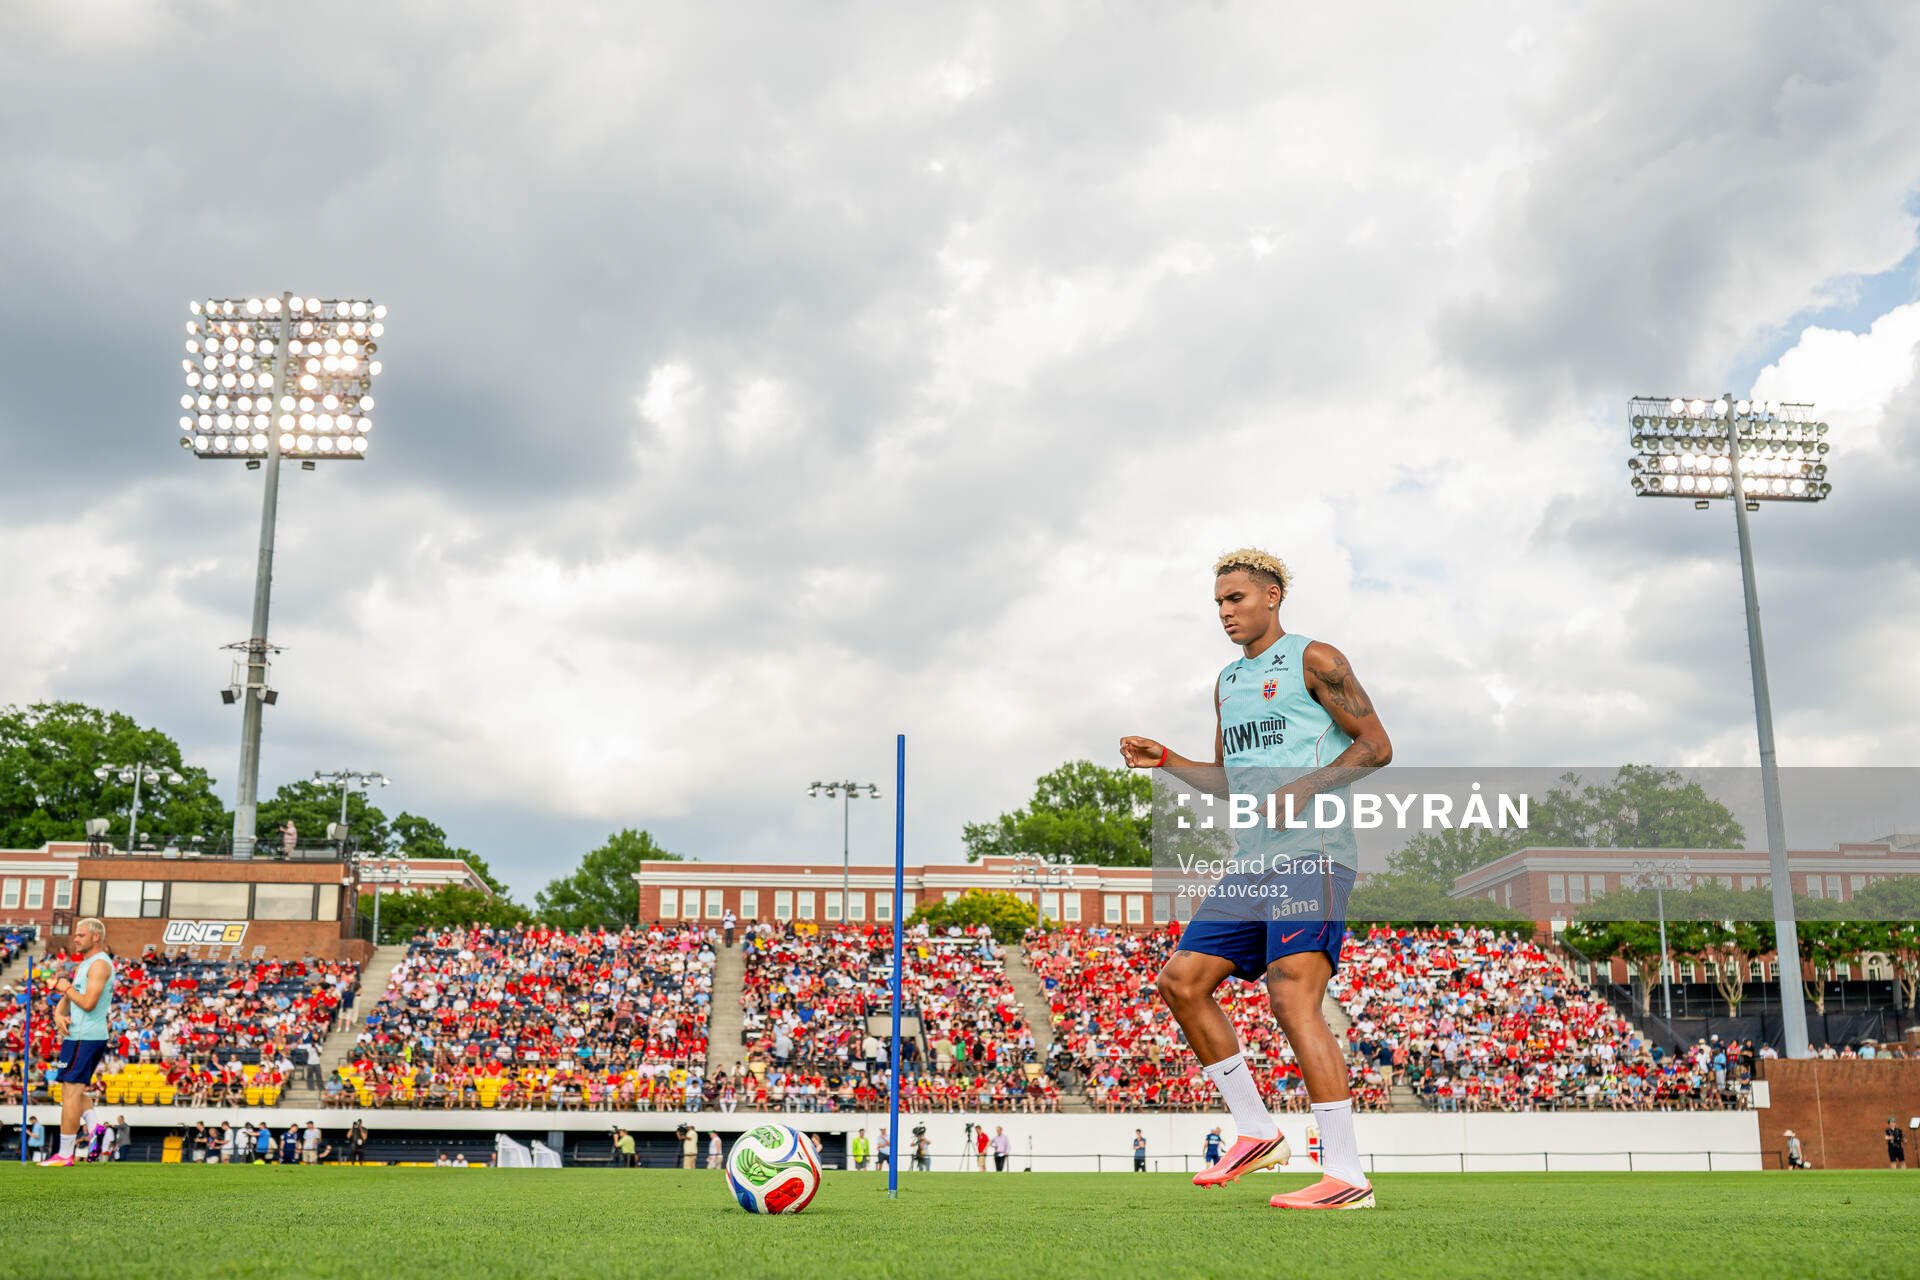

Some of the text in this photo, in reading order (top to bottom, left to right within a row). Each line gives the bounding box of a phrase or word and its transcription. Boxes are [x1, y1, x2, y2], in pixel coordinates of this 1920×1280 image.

[1260, 716, 1286, 732] mini
[1223, 721, 1260, 756] KIWI
[1262, 731, 1284, 750] pris
[165, 921, 247, 944] UNCG
